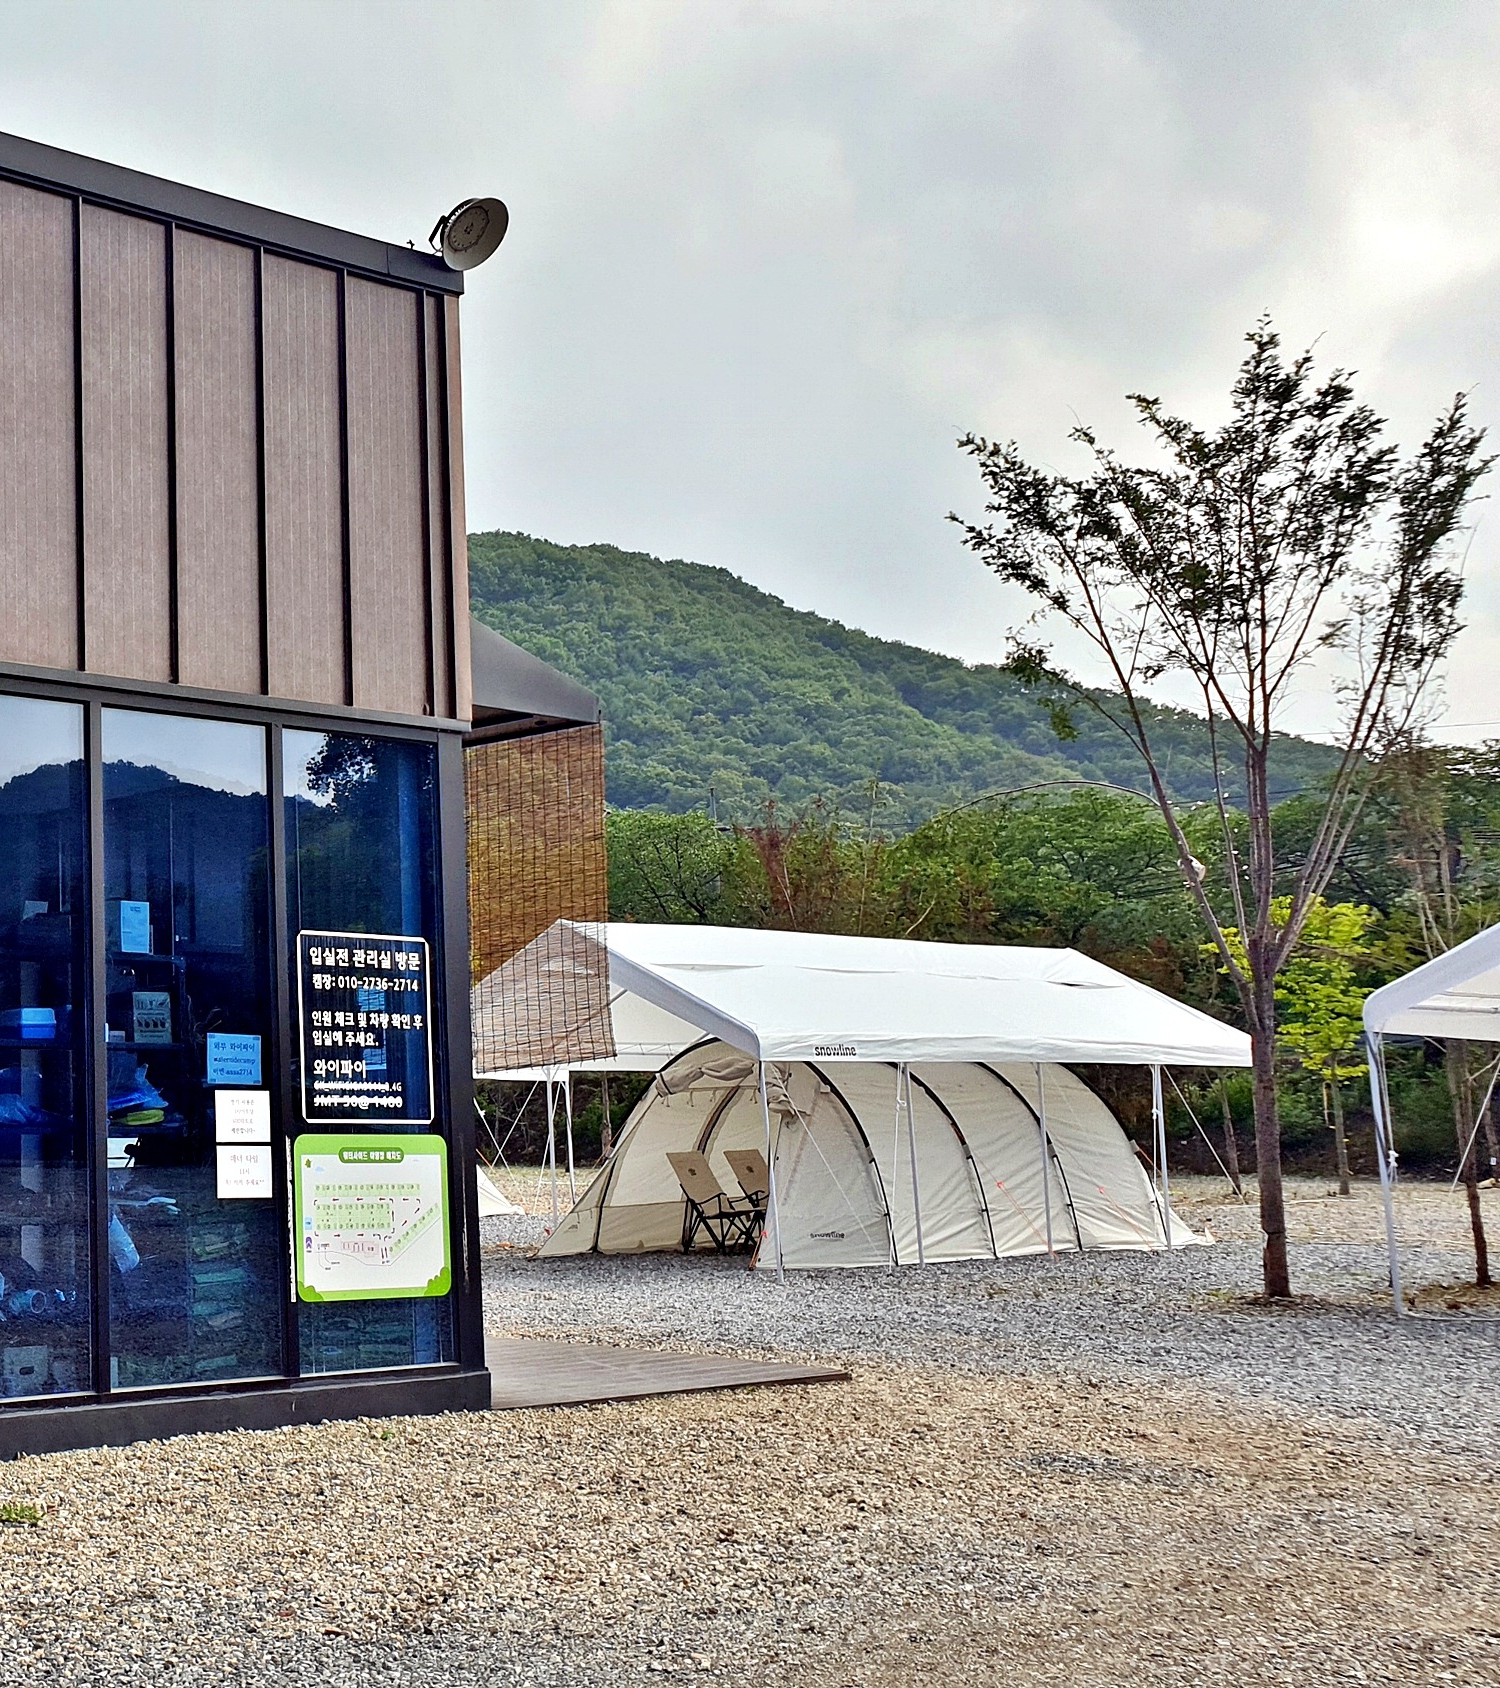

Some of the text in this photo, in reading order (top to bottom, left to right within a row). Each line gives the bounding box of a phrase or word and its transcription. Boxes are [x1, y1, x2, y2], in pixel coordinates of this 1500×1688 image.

[309, 946, 420, 971] 입실전 관리실 방문
[337, 975, 419, 991] 010-2736-2714
[311, 1010, 423, 1030] 인원 체크 및 차량 확인 후
[345, 1031, 379, 1047] 주세요.
[814, 1044, 857, 1056] snowline
[313, 1059, 367, 1078] 와이파이
[809, 1230, 845, 1239] snowline
